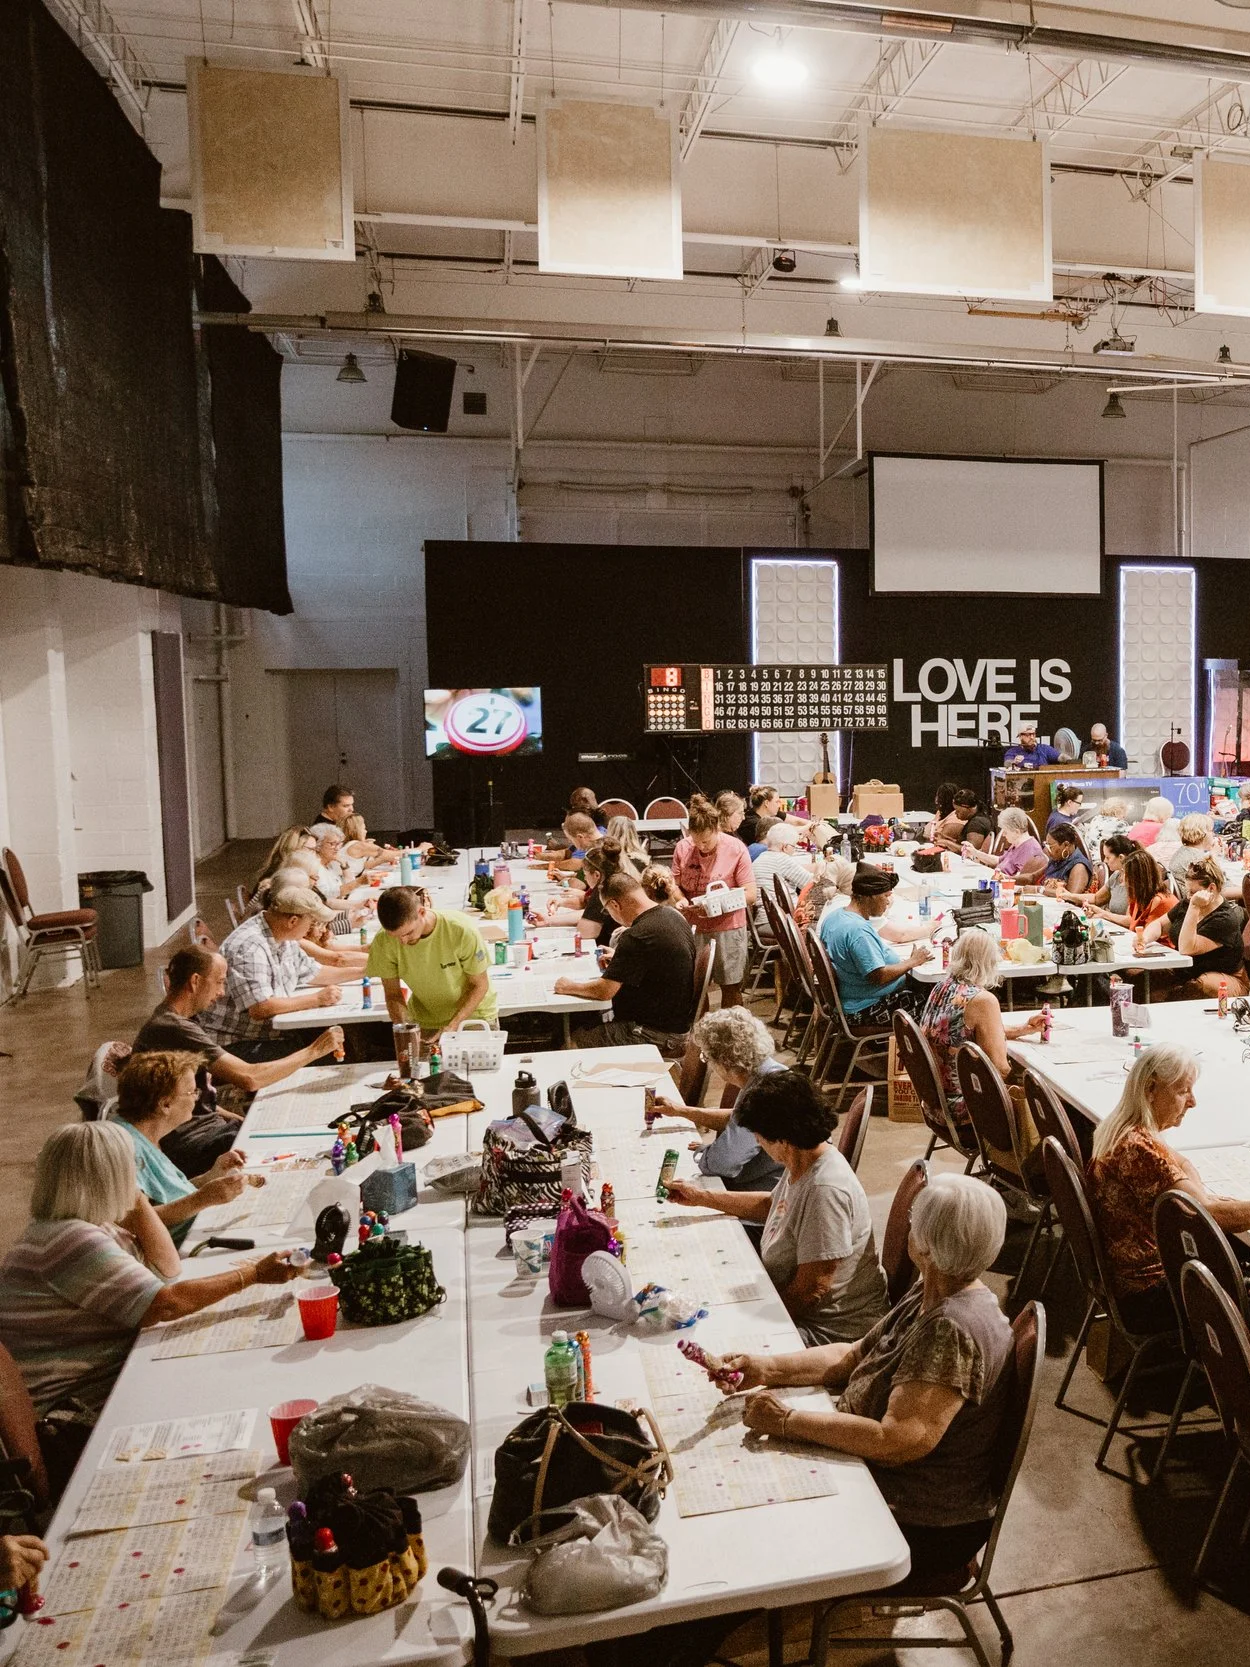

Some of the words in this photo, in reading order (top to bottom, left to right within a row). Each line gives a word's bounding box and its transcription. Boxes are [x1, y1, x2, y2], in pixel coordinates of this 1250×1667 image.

[715, 669, 720, 679] 1
[728, 670, 733, 679] 2
[740, 669, 745, 679] 3
[751, 670, 756, 678] 4
[763, 670, 768, 679] 5
[775, 669, 780, 679] 6
[786, 670, 791, 678] 7
[799, 669, 804, 678] 8
[811, 669, 816, 678] 9
[821, 669, 829, 678] 10
[832, 669, 840, 678] 11
[843, 669, 851, 678] 12
[855, 669, 863, 678] 13
[866, 669, 874, 678] 14
[877, 669, 885, 678] 15
[893, 657, 1017, 703] LOVE
[1030, 658, 1073, 703] IS
[715, 682, 723, 692] 16
[727, 682, 735, 691] 17
[738, 682, 747, 691] 18
[750, 682, 758, 691] 19
[761, 682, 770, 691] 20
[773, 682, 781, 691] 21
[784, 682, 793, 691] 22
[797, 681, 807, 690] 23
[809, 681, 818, 690] 24
[820, 681, 830, 690] 25
[832, 681, 841, 690] 26
[843, 681, 852, 690] 27
[854, 681, 864, 690] 28
[865, 681, 875, 690] 29
[877, 681, 886, 690] 30
[715, 694, 724, 704] 31
[726, 694, 736, 704] 32
[738, 694, 748, 703] 33
[750, 694, 759, 703] 34
[761, 694, 771, 703] 35
[773, 694, 782, 703] 36
[784, 694, 794, 703] 37
[797, 694, 807, 703] 38
[809, 694, 818, 703] 39
[821, 693, 830, 703] 40
[832, 694, 841, 702] 41
[843, 693, 852, 702] 42
[855, 693, 864, 702] 43
[866, 693, 875, 702] 44
[877, 693, 886, 702] 45
[714, 707, 724, 716] 46
[726, 707, 735, 716] 47
[738, 707, 748, 716] 48
[750, 706, 759, 716] 49
[762, 706, 771, 715] 50
[774, 706, 782, 715] 51
[785, 706, 794, 715] 52
[798, 706, 807, 715] 53
[809, 706, 818, 715] 54
[821, 706, 830, 715] 55
[832, 706, 841, 715] 56
[844, 705, 853, 714] 57
[855, 705, 864, 714] 58
[866, 705, 875, 714] 59
[877, 705, 886, 714] 60
[466, 707, 513, 735] 27
[715, 720, 724, 729] 61
[726, 719, 736, 729] 62
[738, 719, 748, 729] 63
[750, 719, 759, 728] 64
[762, 719, 771, 728] 65
[773, 719, 783, 728] 66
[785, 719, 794, 728] 67
[798, 718, 807, 727] 68
[810, 718, 819, 727] 69
[821, 718, 830, 727] 70
[833, 718, 842, 727] 71
[844, 718, 853, 727] 72
[855, 718, 864, 727] 73
[866, 718, 875, 727] 74
[877, 718, 887, 727] 75
[1173, 782, 1206, 805] 70"
